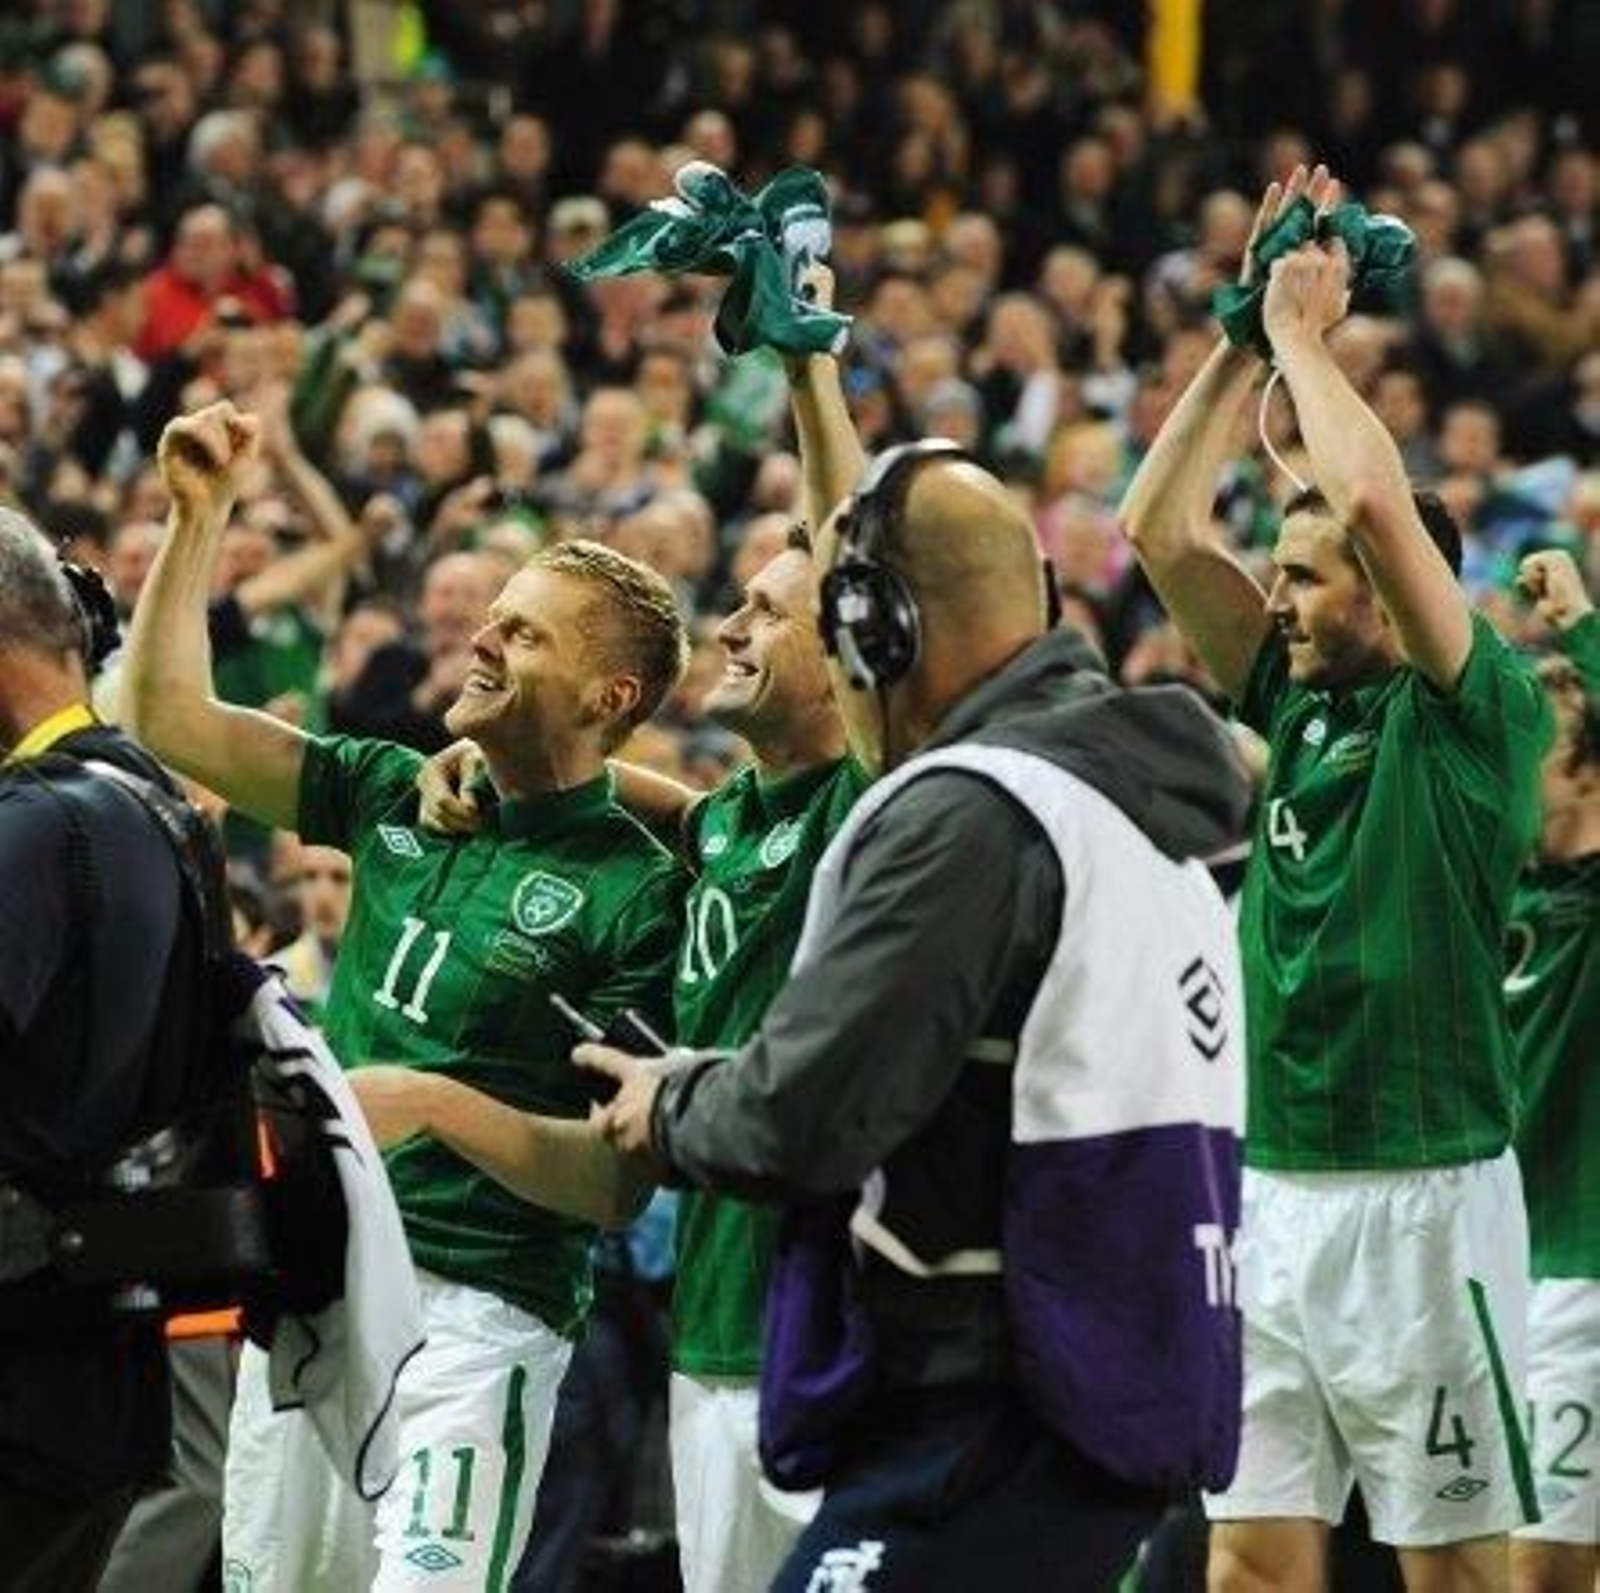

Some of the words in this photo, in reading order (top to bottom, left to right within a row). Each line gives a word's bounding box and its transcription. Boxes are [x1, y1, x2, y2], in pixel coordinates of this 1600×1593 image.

[1267, 798, 1308, 861] 4
[373, 916, 451, 1025] 11
[679, 887, 738, 983] 10
[1424, 1385, 1476, 1468] 4
[403, 1447, 476, 1541] 11
